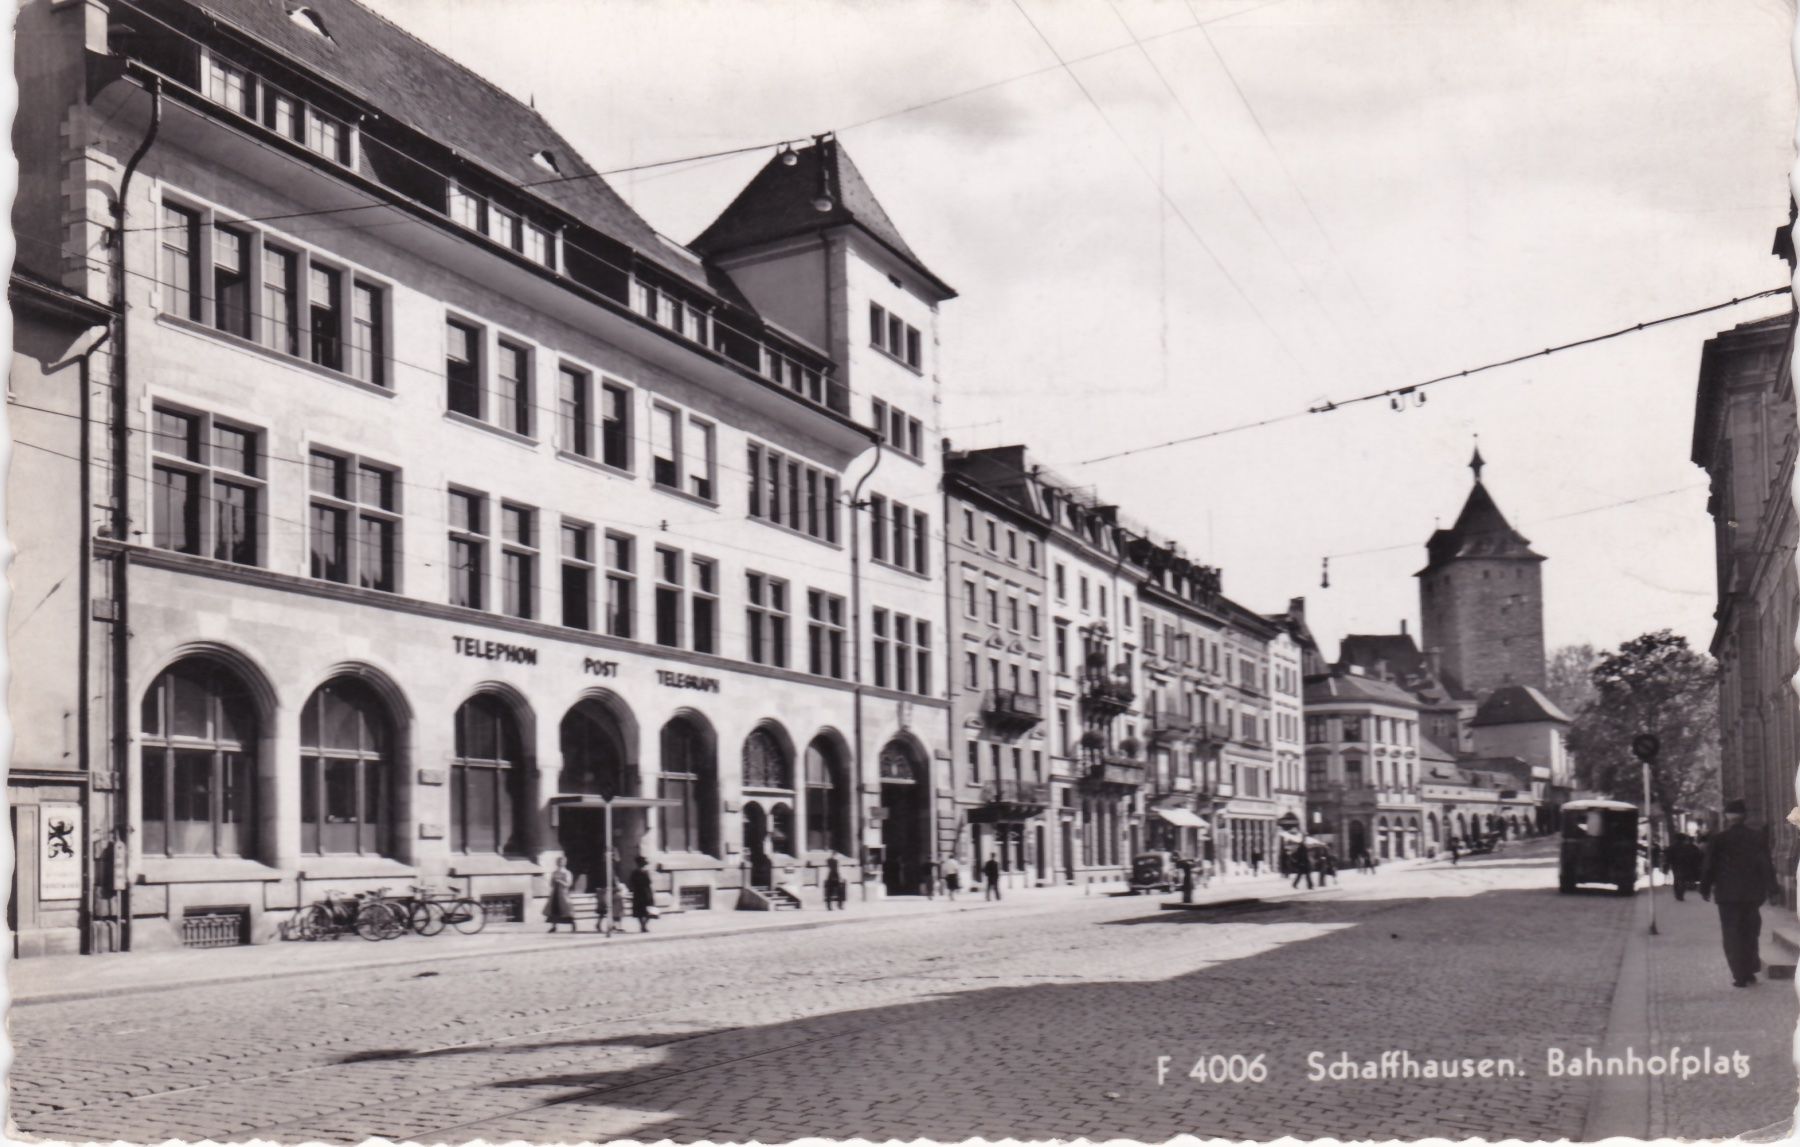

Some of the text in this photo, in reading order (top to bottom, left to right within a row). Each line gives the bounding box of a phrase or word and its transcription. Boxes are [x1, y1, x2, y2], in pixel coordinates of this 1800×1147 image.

[452, 635, 720, 694] TELEPHON POST TELEGRAPH
